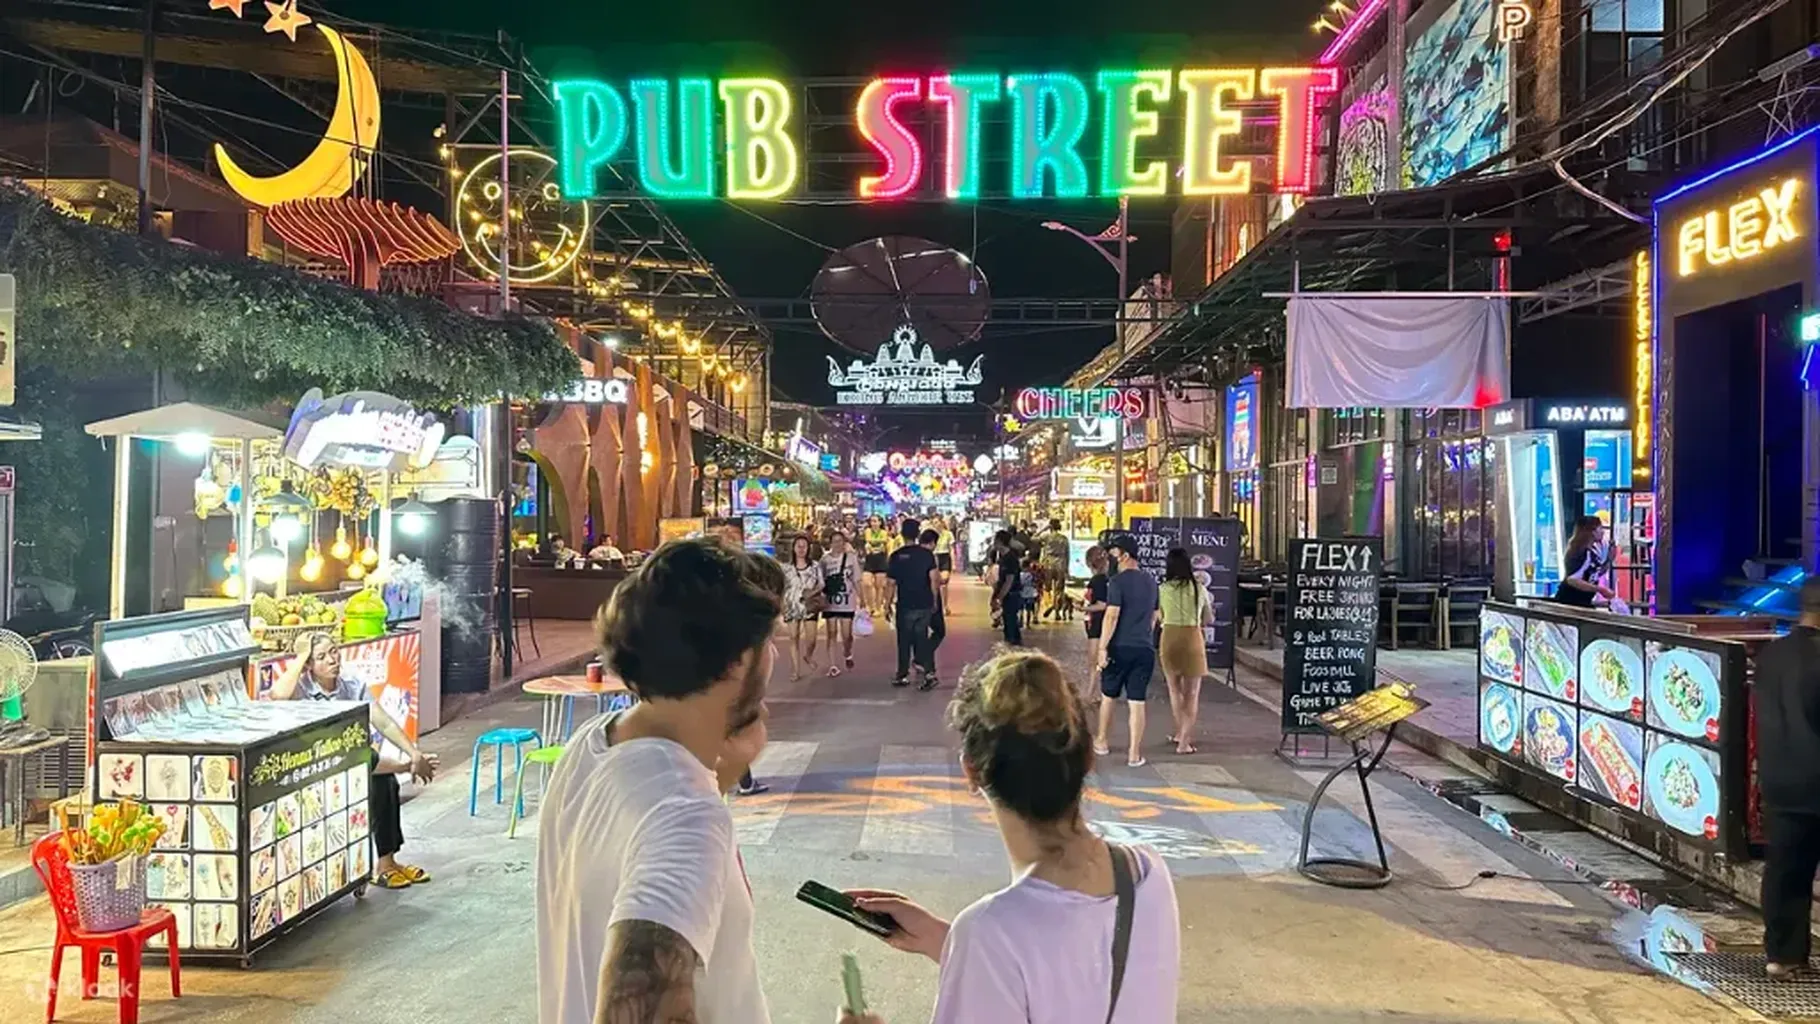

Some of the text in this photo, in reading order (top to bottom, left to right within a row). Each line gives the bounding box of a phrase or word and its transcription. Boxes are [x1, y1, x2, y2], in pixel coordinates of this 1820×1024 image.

[552, 65, 1339, 200] PUB STREET
[1679, 178, 1801, 277] FLEX
[1016, 387, 1145, 419] CHEERS
[1589, 407, 1626, 422] ATM
[1190, 534, 1230, 547] MENU
[1301, 543, 1357, 572] FLEX
[1337, 575, 1375, 588] NIGHT
[1300, 589, 1335, 604] FREE
[1294, 606, 1314, 620] FOR
[1293, 630, 1305, 646] 2
[1330, 628, 1370, 643] TABLES
[1304, 646, 1366, 664] BEER PONG
[1301, 680, 1330, 695] LIVE
